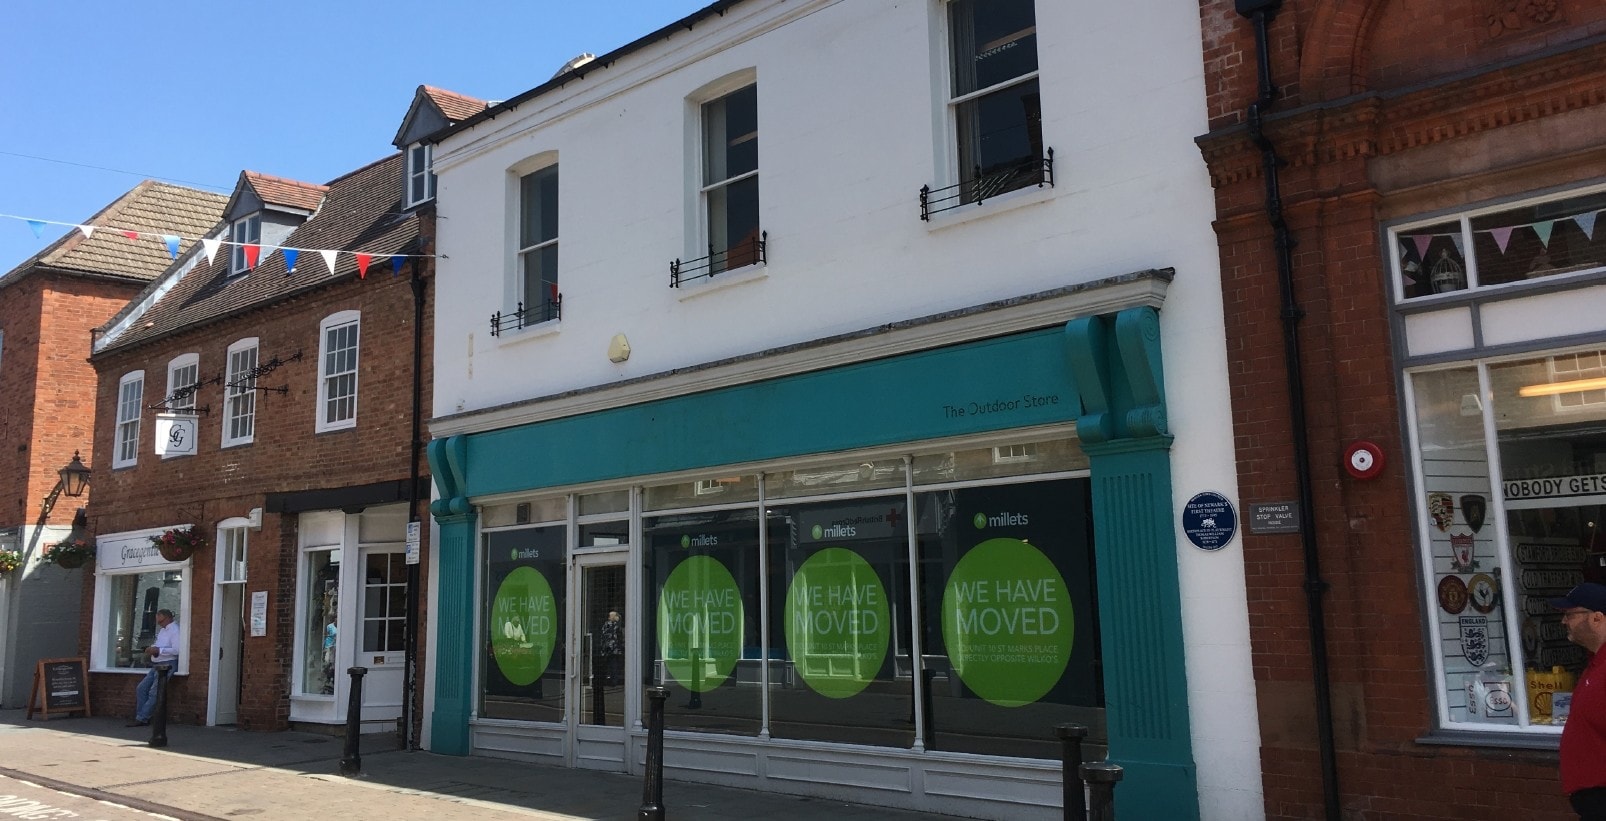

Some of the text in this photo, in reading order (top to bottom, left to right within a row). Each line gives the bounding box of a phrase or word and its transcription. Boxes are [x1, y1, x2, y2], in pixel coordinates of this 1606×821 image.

[943, 394, 1059, 419] The Outdoor Store
[1258, 505, 1289, 513] SPRINKLER
[989, 512, 1028, 527] millets
[824, 524, 856, 539] millets
[691, 534, 718, 548] millets
[518, 548, 539, 560] millets
[668, 588, 735, 609] WE HAVE
[796, 584, 878, 607] WE HAVE
[955, 578, 1057, 604] WE HAVE
[498, 595, 550, 613] WE HAVE
[498, 616, 550, 636] MVED
[668, 612, 736, 635] MOVED
[795, 609, 879, 636] MOVED
[957, 607, 1060, 636] MOVED
[990, 654, 1026, 663] OPPOSITE
[998, 645, 1005, 653] ST
[1035, 646, 1058, 654] PLACE
[1530, 680, 1562, 690] Shell
